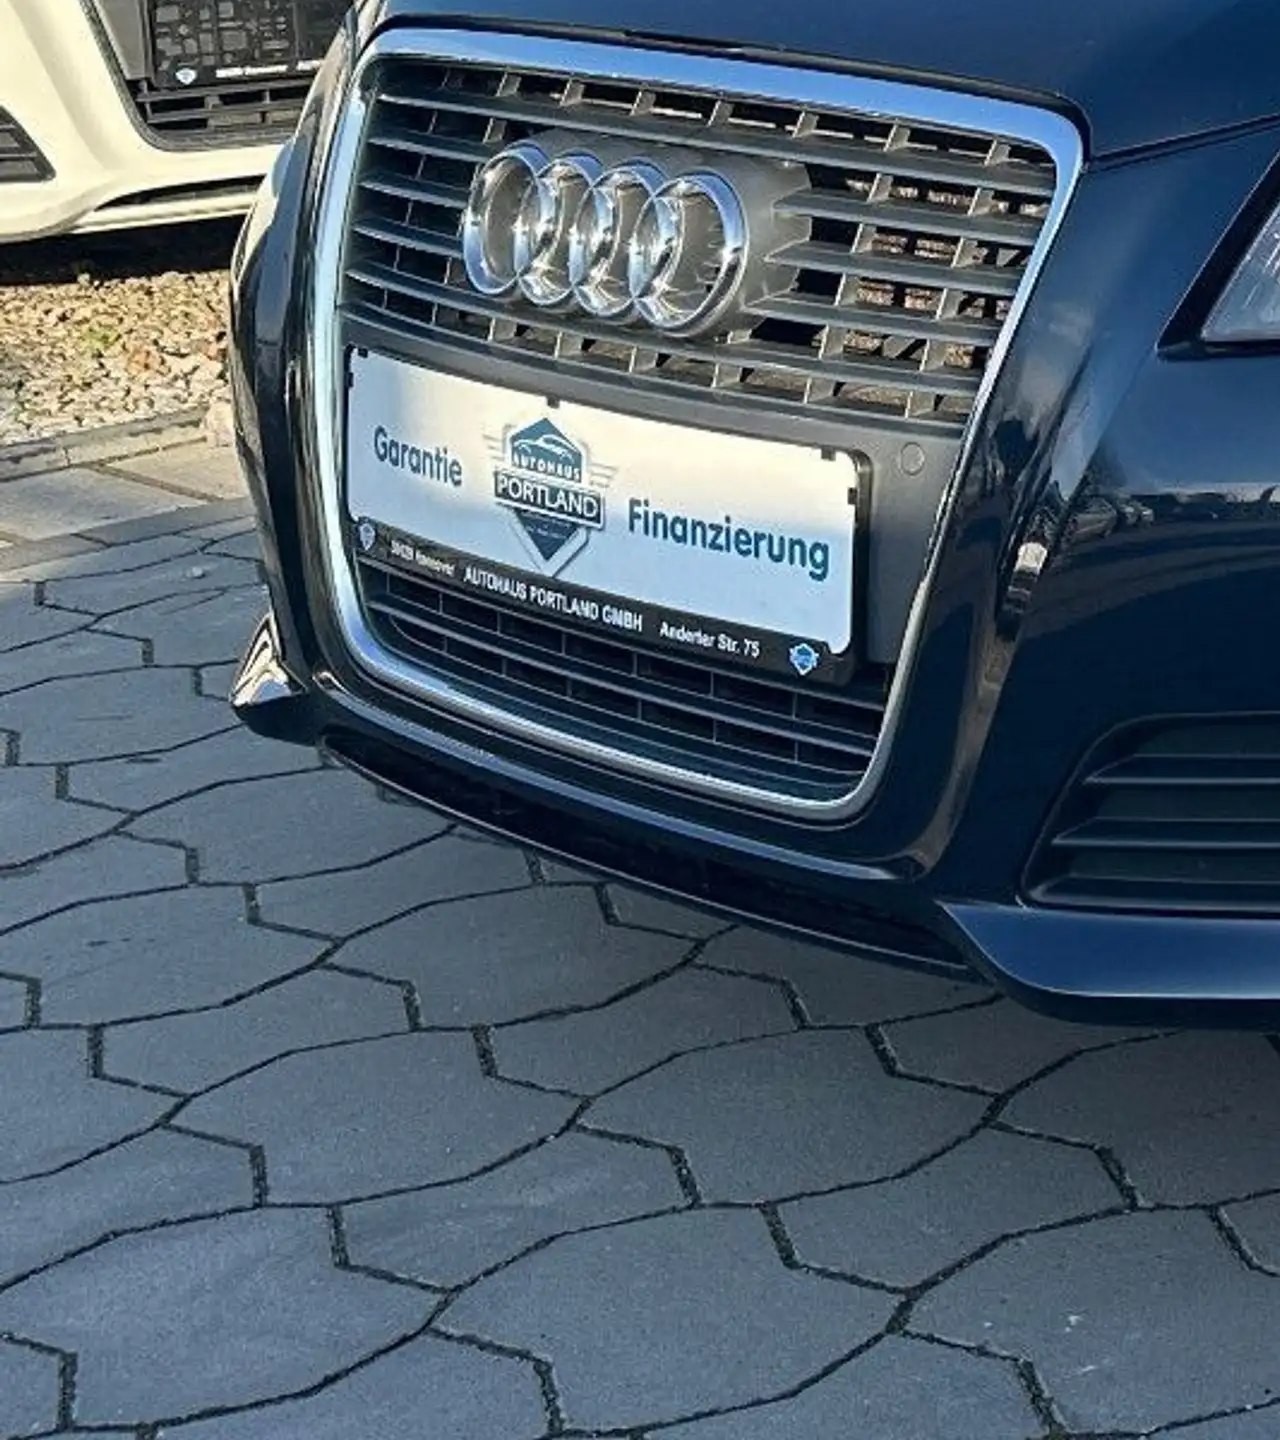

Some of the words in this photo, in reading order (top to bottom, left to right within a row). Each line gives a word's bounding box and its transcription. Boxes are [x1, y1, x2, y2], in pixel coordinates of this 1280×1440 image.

[374, 425, 463, 487] Garantie
[511, 453, 581, 482] AUTOHAUS
[497, 474, 599, 519] PORTLAND
[628, 497, 831, 582] Finanzierung
[463, 566, 527, 600] AUTOHAUS
[529, 585, 599, 620] PORTLAND
[602, 602, 644, 633] GMBH
[717, 633, 740, 654] Str.
[743, 638, 761, 659] 75
